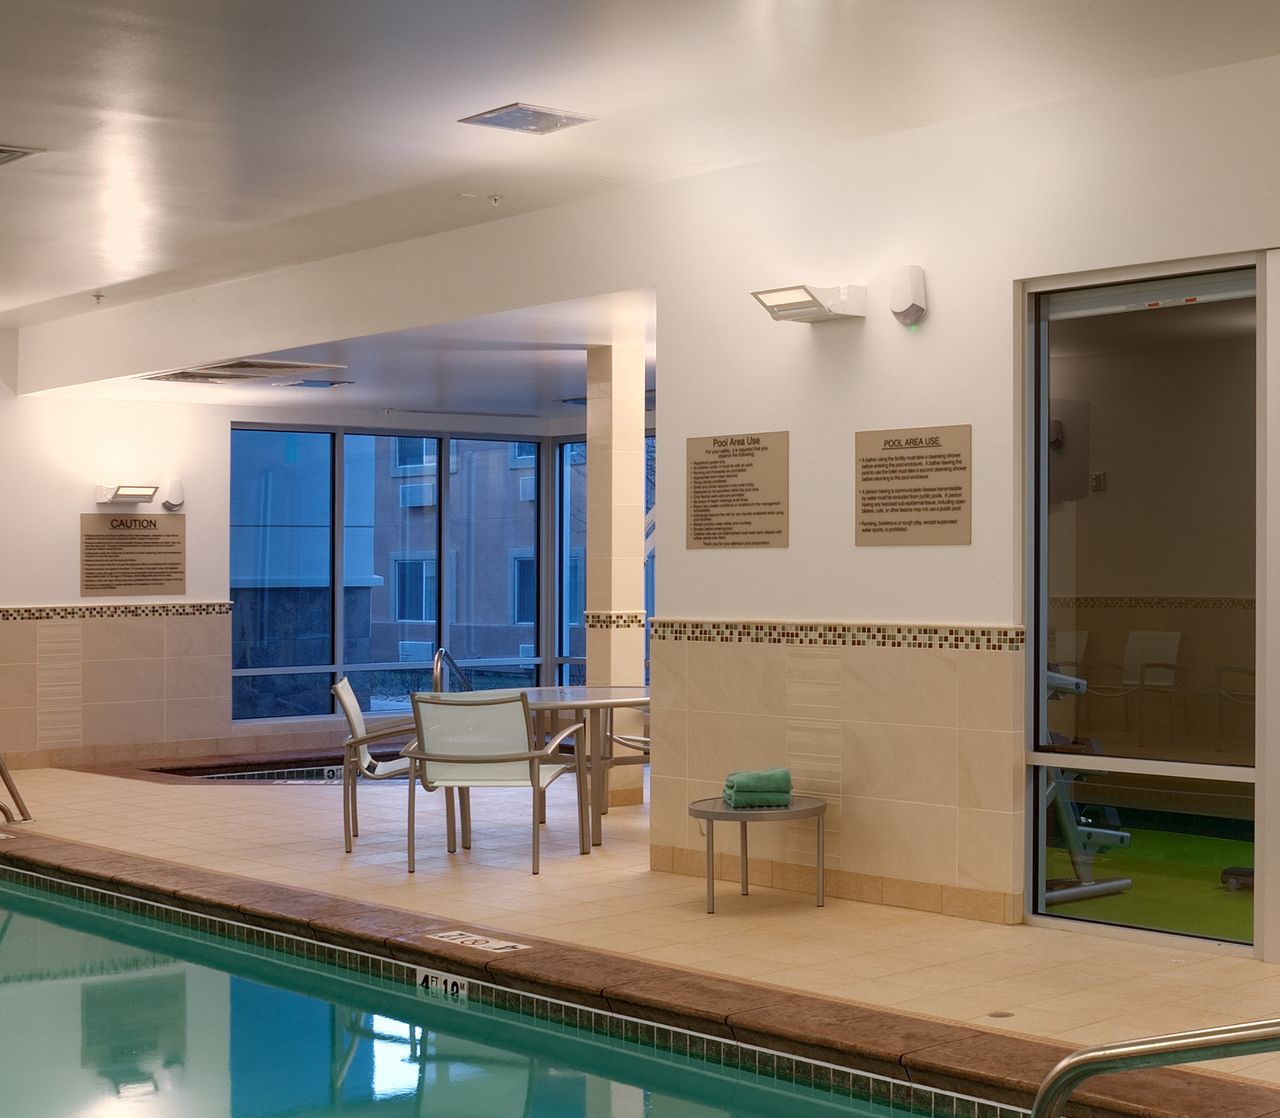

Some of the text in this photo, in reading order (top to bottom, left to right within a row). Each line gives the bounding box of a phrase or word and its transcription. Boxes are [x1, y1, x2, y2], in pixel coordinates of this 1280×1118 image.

[713, 436, 760, 448] Pool Area Use
[884, 437, 940, 448] POOL AREA USE
[111, 519, 157, 528] CAUTION
